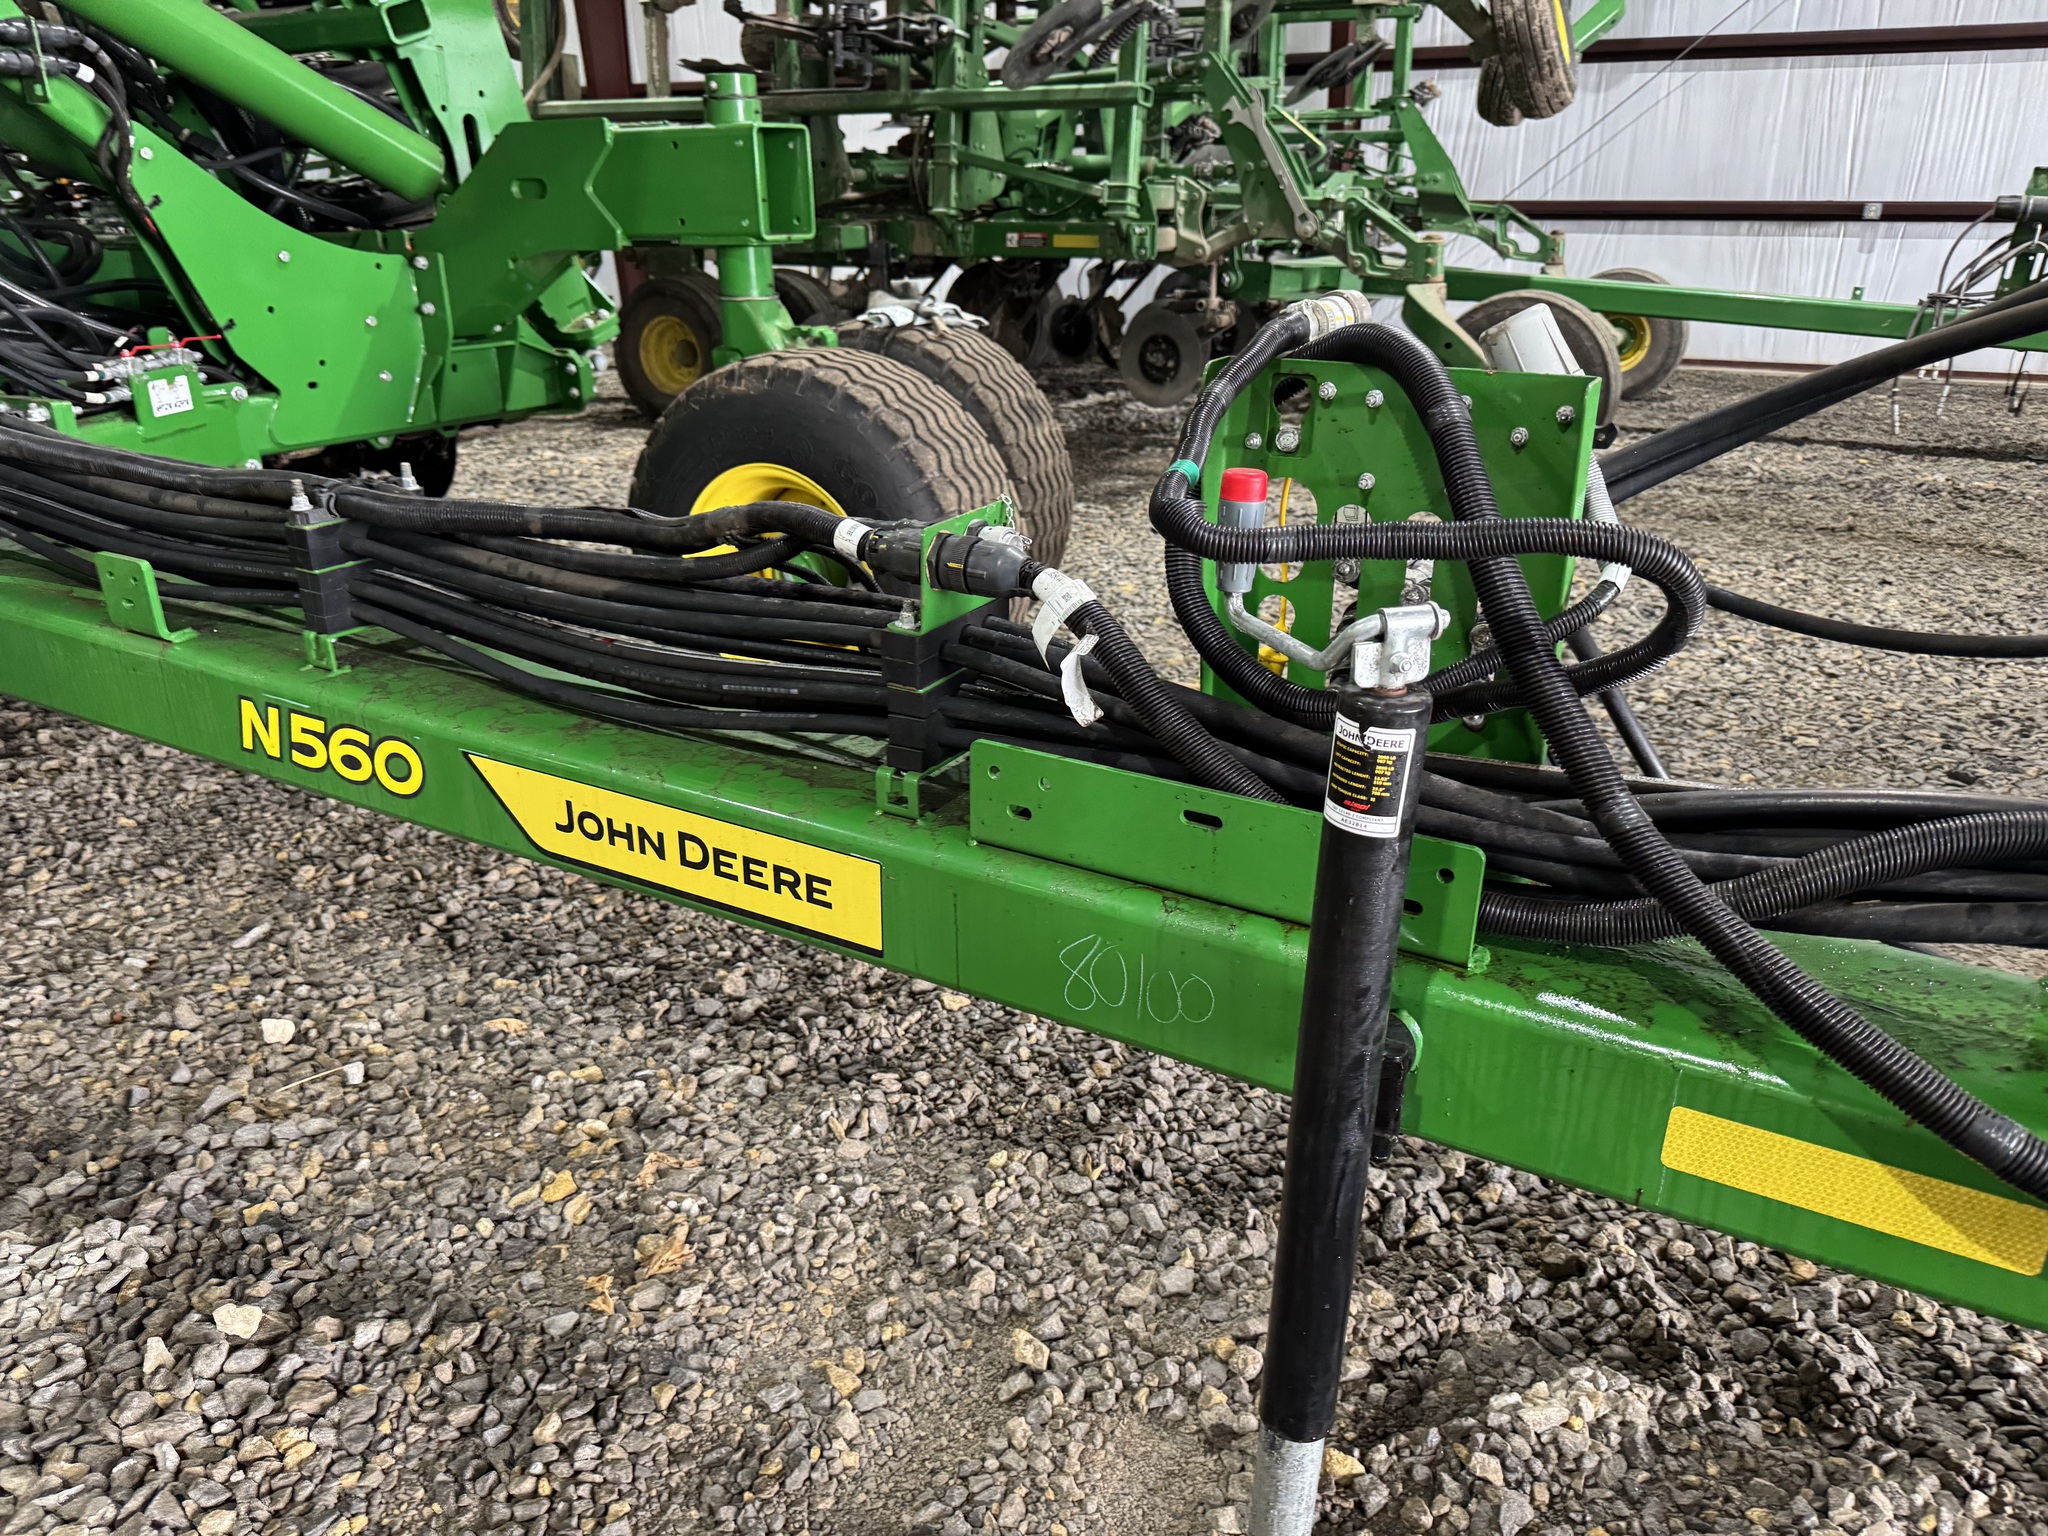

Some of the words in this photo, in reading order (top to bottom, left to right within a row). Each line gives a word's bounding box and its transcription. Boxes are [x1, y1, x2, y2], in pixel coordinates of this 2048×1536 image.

[240, 698, 424, 797] N560
[1339, 725, 1362, 742] JOHN
[1366, 735, 1405, 749] DEERE
[555, 800, 666, 861] JOHN
[677, 830, 833, 910] DEERE
